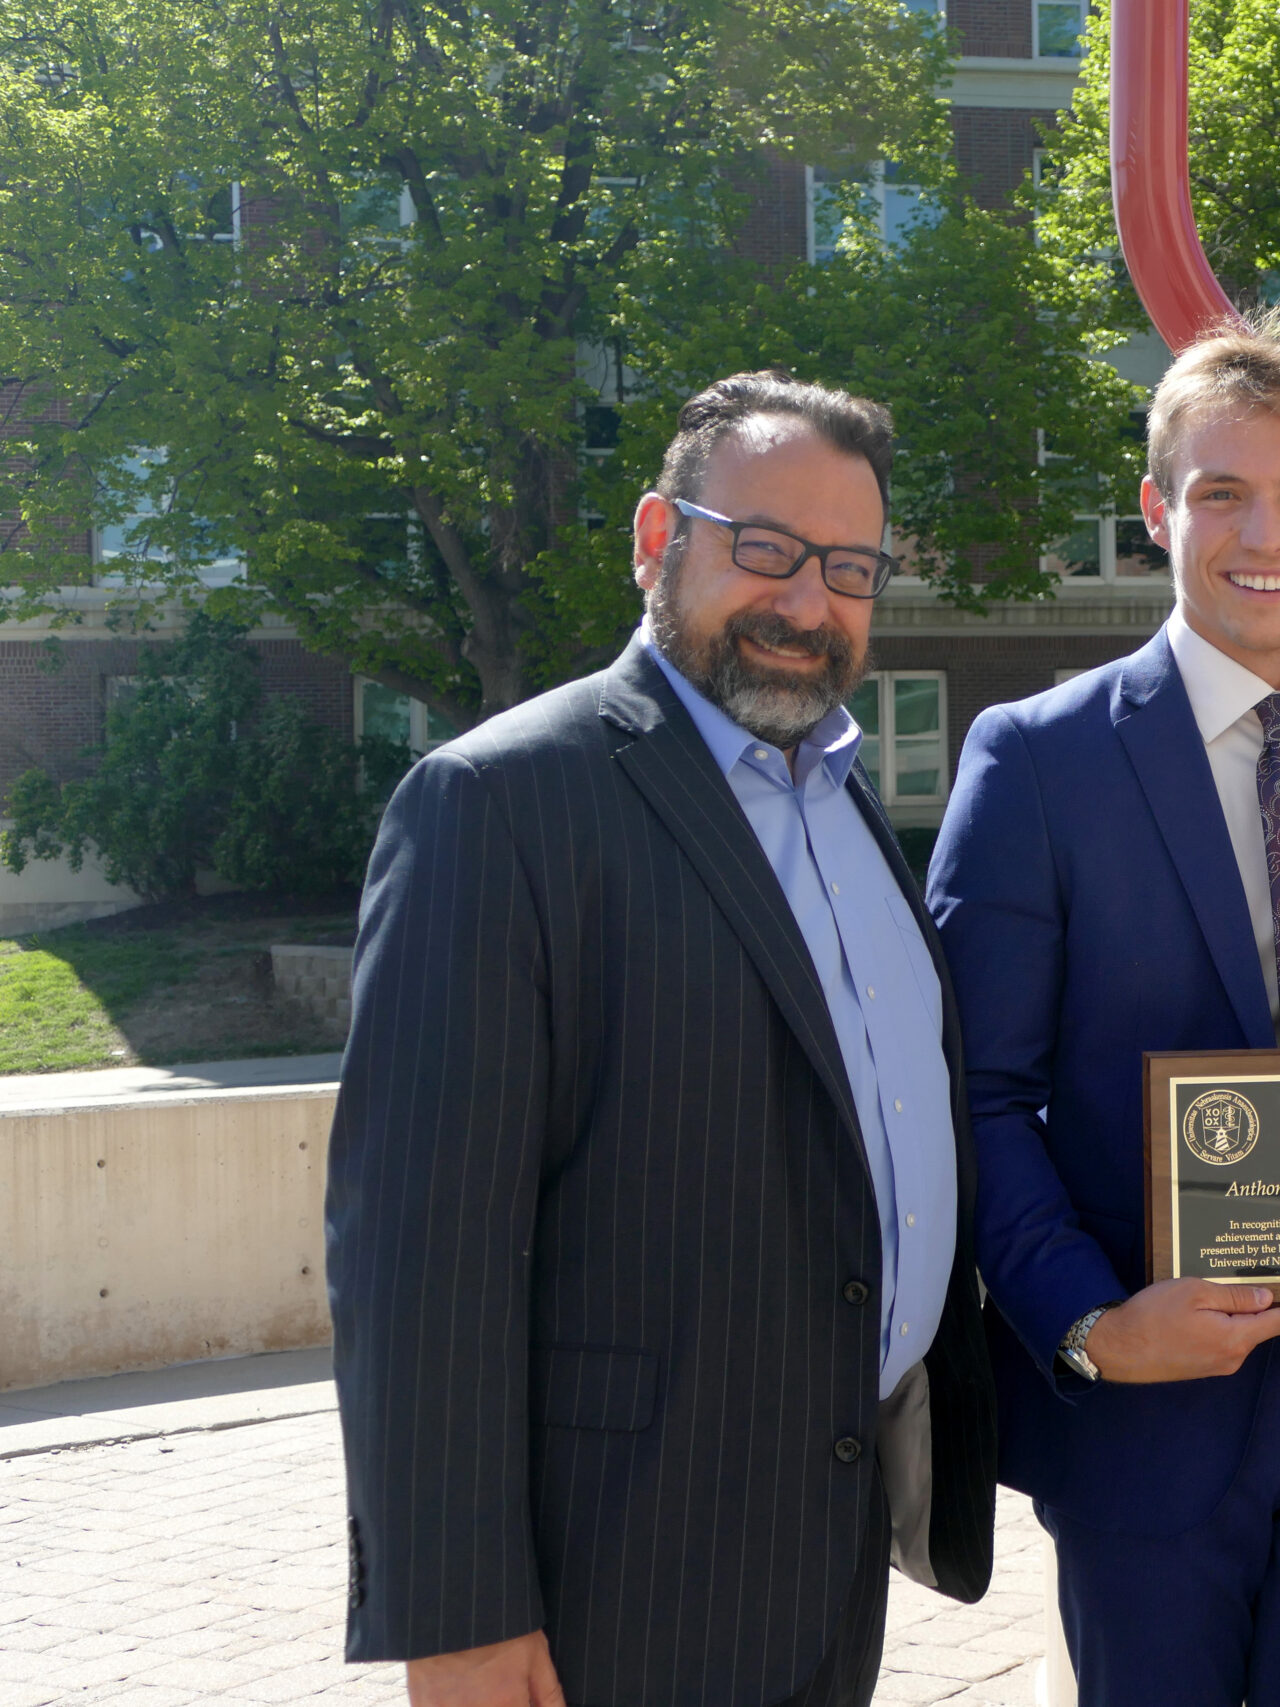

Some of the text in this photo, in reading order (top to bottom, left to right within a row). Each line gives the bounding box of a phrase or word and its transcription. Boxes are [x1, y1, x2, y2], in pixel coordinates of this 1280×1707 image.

[1200, 1149, 1223, 1162] Servare
[1229, 1220, 1240, 1229] In
[1215, 1233, 1273, 1242] achievement
[1200, 1245, 1245, 1258] presented
[1247, 1245, 1259, 1256] by
[1261, 1244, 1276, 1253] the
[1209, 1257, 1257, 1269] University
[1260, 1256, 1270, 1266] of
